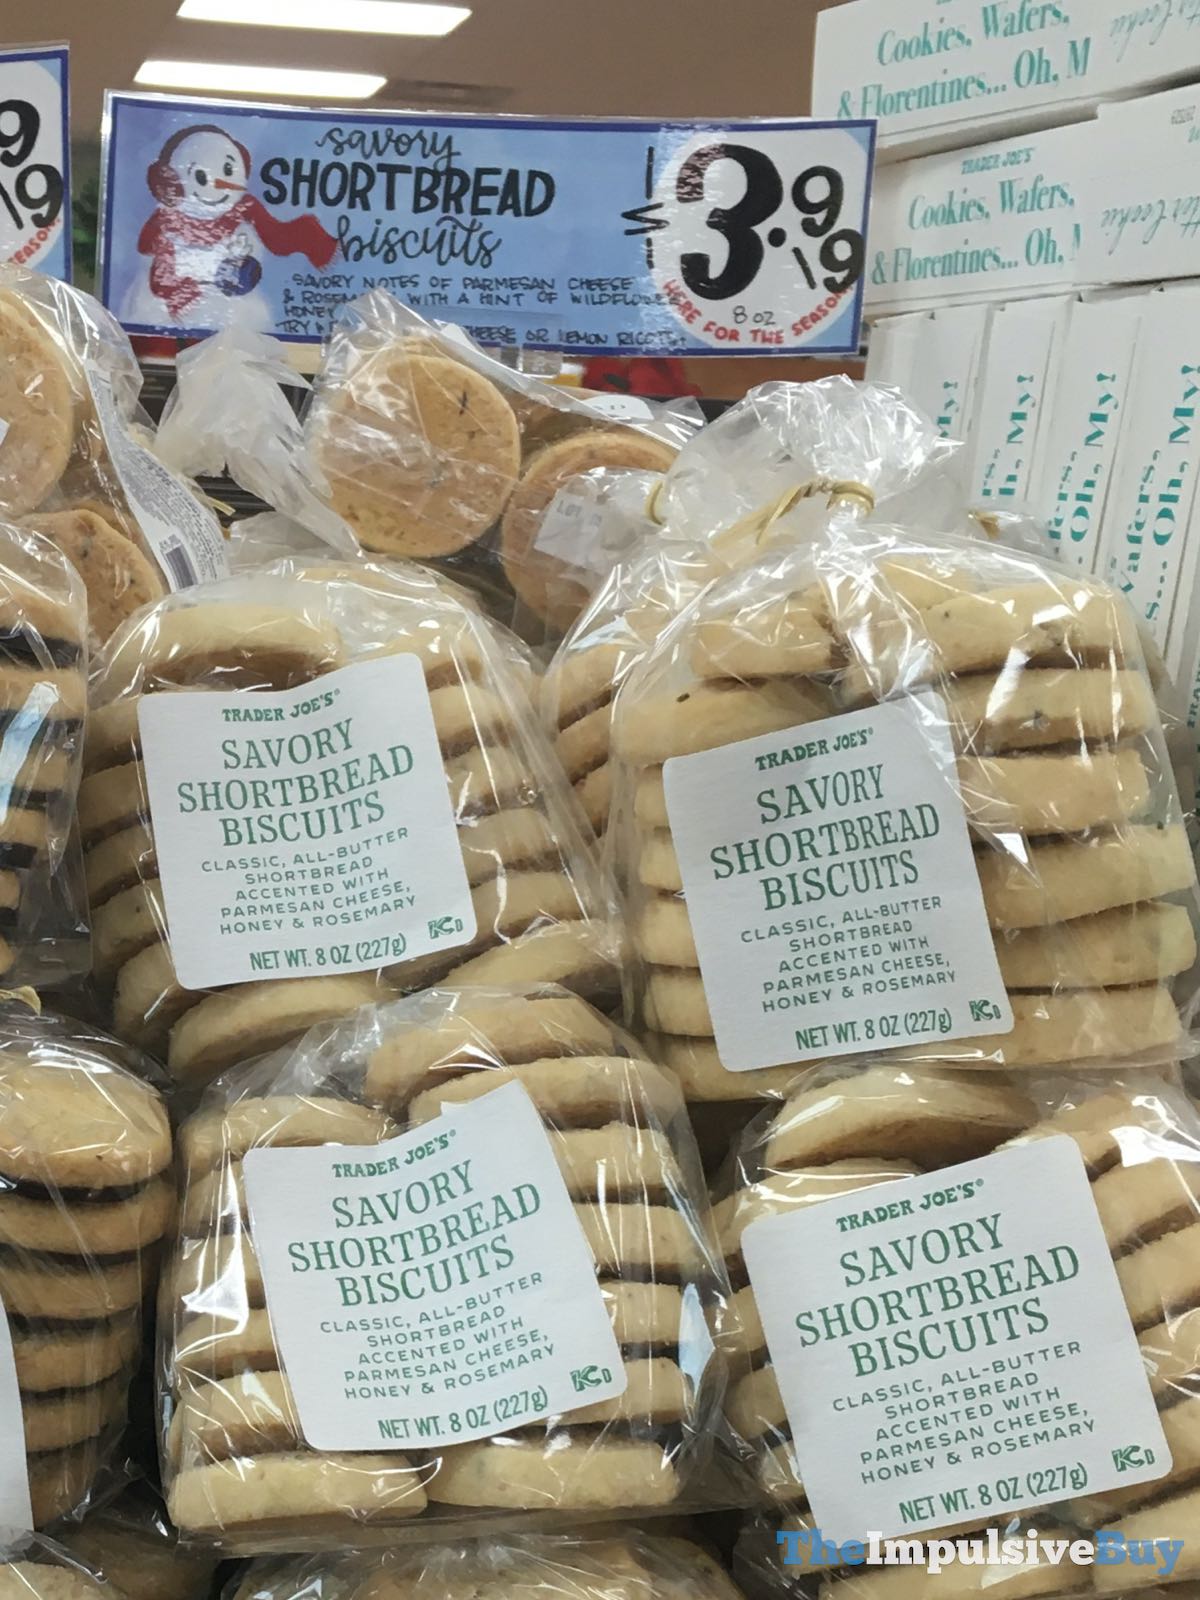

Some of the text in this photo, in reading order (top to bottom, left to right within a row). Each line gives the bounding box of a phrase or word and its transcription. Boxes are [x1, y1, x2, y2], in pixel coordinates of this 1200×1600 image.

[877, 17, 972, 66] Cookies,
[837, 90, 852, 119] &
[316, 127, 460, 172] savory
[260, 157, 555, 218] SHORTBREAD
[908, 187, 990, 230] Cookies,
[336, 214, 502, 269] biscuits
[292, 273, 634, 291] SAVORY NOTES OF PARMESAN CHEESE
[871, 251, 886, 285] &
[284, 304, 335, 319] HONEY
[408, 292, 449, 306] WITH
[457, 293, 470, 304] A
[479, 293, 525, 306] HINT
[537, 290, 558, 305] OF
[733, 305, 748, 324] 8
[275, 319, 311, 335] TRY
[703, 321, 740, 342] FOR
[751, 329, 784, 344] THE
[1007, 374, 1036, 444] My!
[1070, 372, 1119, 543] Oh, My!
[1153, 461, 1189, 546] Oh,
[222, 708, 285, 722] TRADER
[222, 718, 353, 770] SAVORY
[755, 742, 829, 770] TRADER
[178, 744, 414, 813] SHORTBREAD
[757, 765, 884, 824] SAVORY
[220, 791, 384, 846] BISCUITS
[710, 804, 940, 879] SHORTBREAD
[202, 827, 408, 872] CLASSIC, ALL-BUTTER
[245, 857, 373, 884] SHORTBREAD
[221, 881, 411, 918] PARMESAN CHEESE,
[236, 868, 389, 901] ACCENTED WITH
[760, 850, 918, 910] BISCUITS
[220, 896, 416, 935] HONEY & ROSEMARY
[741, 896, 941, 942] CLASSIC, ALL-BUTTER
[790, 920, 912, 952] SHORTBREAD
[250, 933, 407, 970] NET WT. 8 OZ (227g)
[764, 954, 949, 994] PARMESAN CHEESE,
[779, 937, 929, 973] ACCENTED WITH
[763, 971, 956, 1012] HONEY & ROSEMARY
[796, 1008, 952, 1050] NET WT. 8 OZ (227g)
[332, 1157, 400, 1177] TRADER
[332, 1159, 474, 1228] SAVORY
[836, 1200, 915, 1233] TRADER
[288, 1183, 541, 1272] SHORTBREAD
[840, 1214, 1003, 1287] SAVORY
[336, 1234, 514, 1306] BISCUITS
[321, 1272, 542, 1333] CLASSIC, ALL-BUTTER
[796, 1245, 1079, 1347] SHORTBREAD
[359, 1317, 523, 1364] ACCENTED WITH
[368, 1306, 504, 1347] SHORTBREAD
[848, 1297, 1049, 1377] BISCUITS
[345, 1329, 548, 1382] PARMESAN CHEESE,
[345, 1343, 555, 1399] HONEY & ROSEMARY
[833, 1341, 1081, 1412] CLASSIC, ALL-BUTTER
[378, 1385, 548, 1438] NET WT. 8 OZ (227g)
[875, 1387, 1060, 1442] ACCENTED WITH
[885, 1372, 1038, 1419] SHORTBREAD
[861, 1403, 1088, 1464] PARMESAN CHEESE,
[861, 1419, 1096, 1484] HONEY & ROSEMARY
[900, 1463, 1088, 1523] NET WT. 8 OZ (227g)
